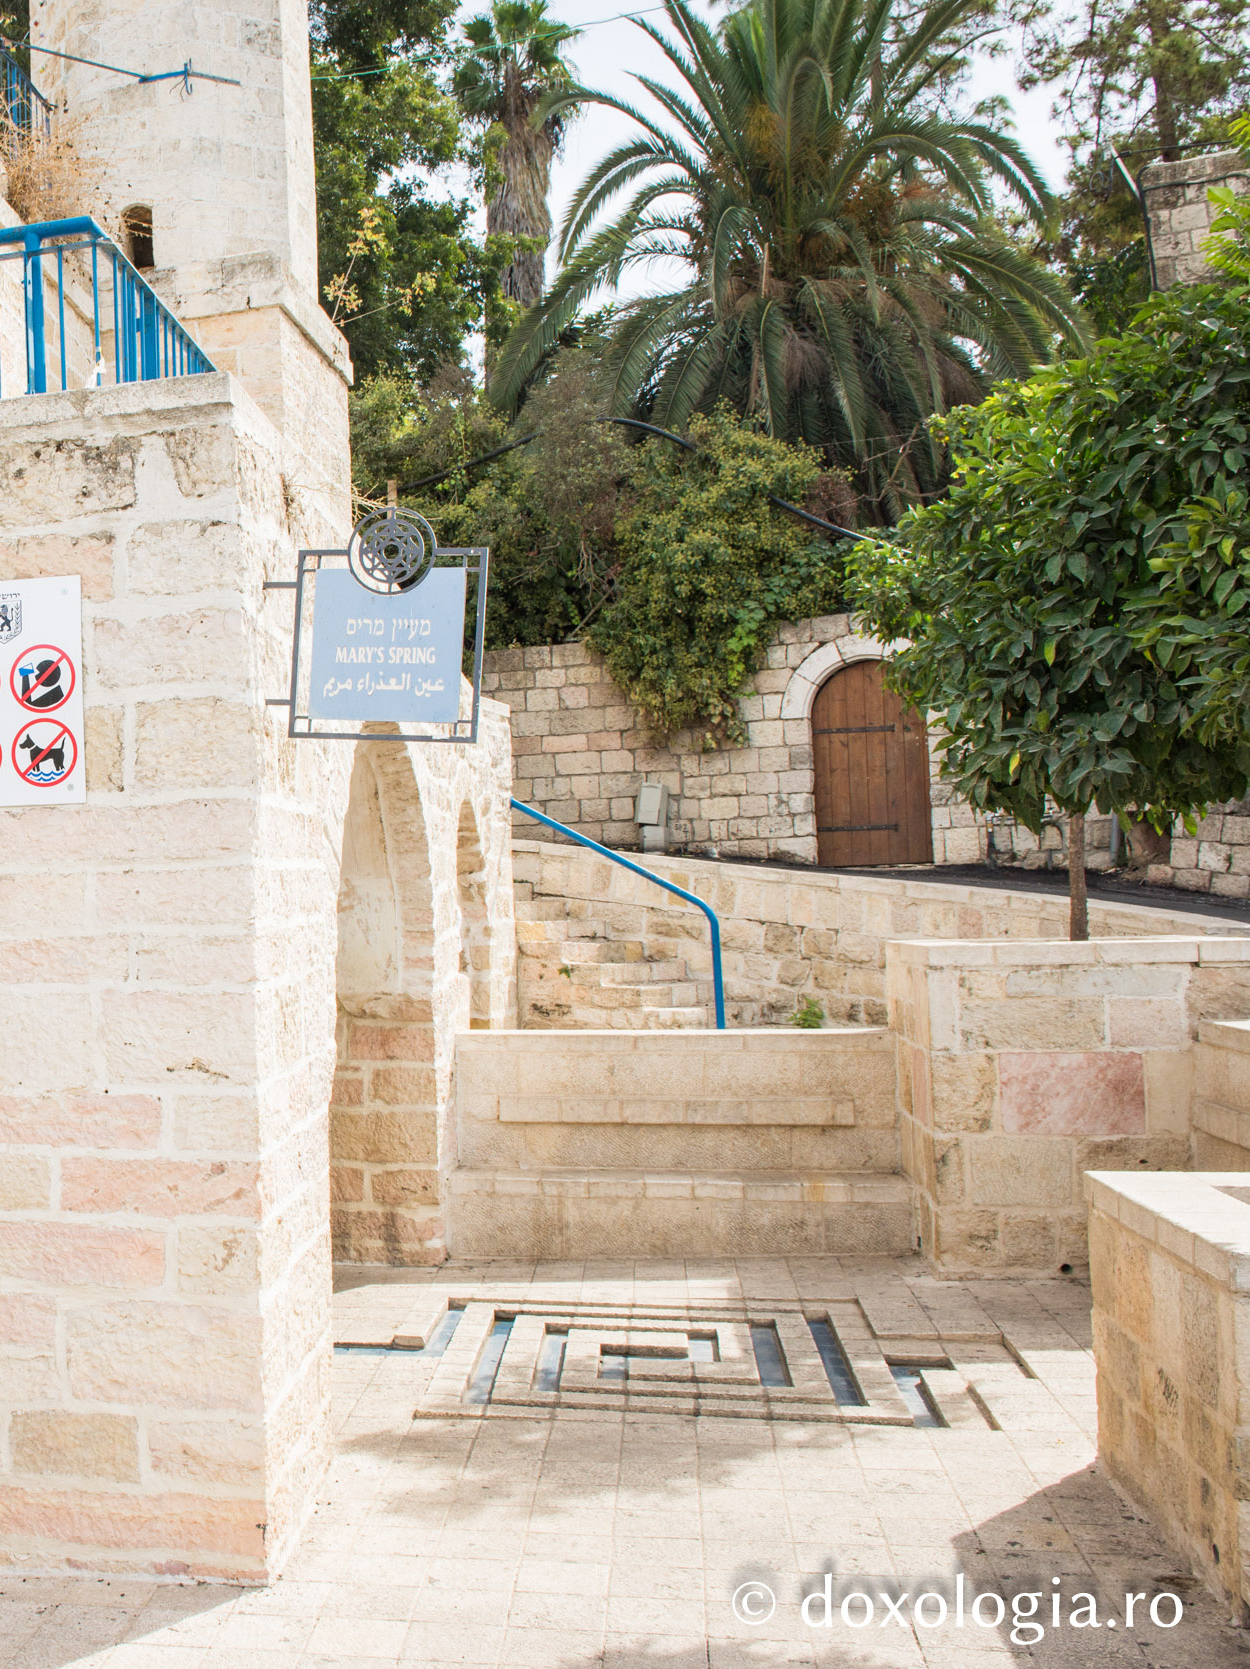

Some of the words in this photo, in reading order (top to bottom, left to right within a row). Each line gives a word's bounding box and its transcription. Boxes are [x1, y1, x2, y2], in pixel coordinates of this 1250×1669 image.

[346, 618, 385, 635] מרים
[391, 618, 431, 641] מעיין
[335, 646, 385, 664] MARY'S
[388, 646, 436, 664] SPRING
[323, 677, 352, 698] مريم
[357, 671, 411, 696] العذراء
[415, 677, 445, 697] عين
